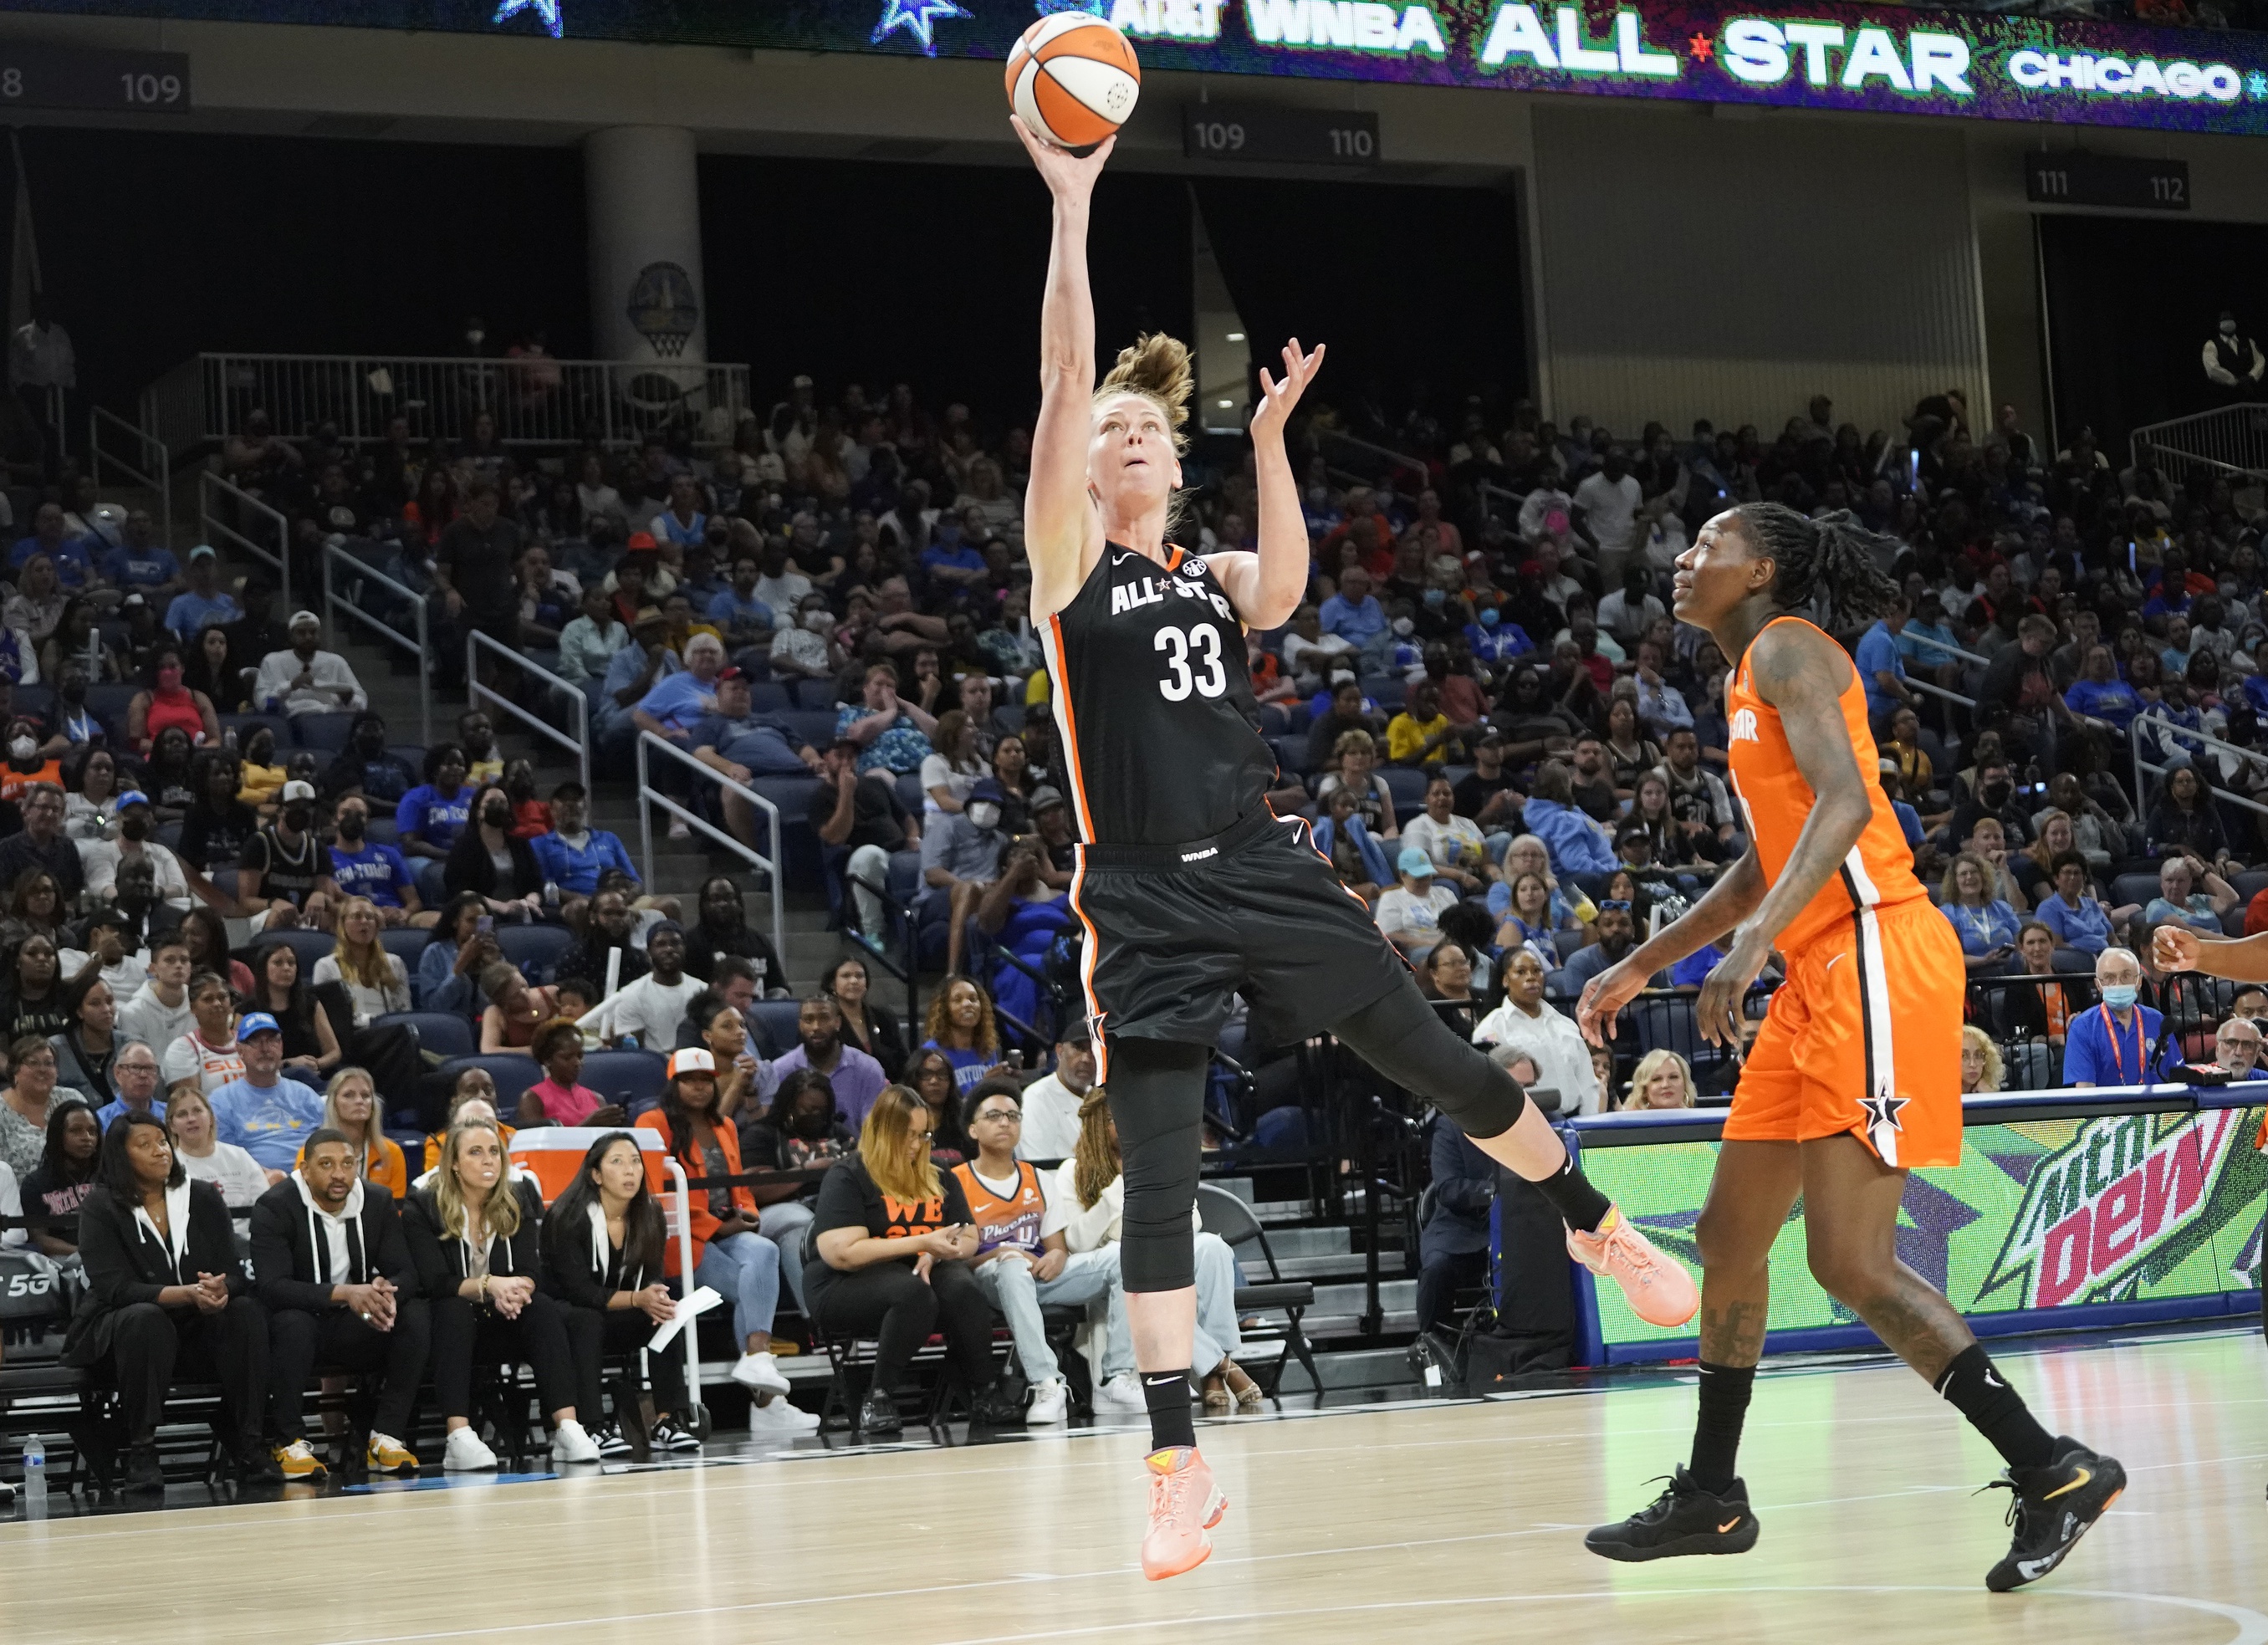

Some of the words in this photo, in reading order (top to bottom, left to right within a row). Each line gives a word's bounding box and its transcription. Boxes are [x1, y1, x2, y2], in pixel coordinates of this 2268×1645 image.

[1247, 0, 1445, 53] WNBA
[1481, 3, 1678, 76] ALL
[1724, 18, 1974, 94] STAR
[2008, 50, 2241, 101] CHICAGO
[121, 72, 181, 105] 109
[1194, 122, 1245, 151] 109
[1331, 129, 1372, 157] 110
[2038, 171, 2068, 197] 111
[2151, 176, 2184, 202] 112
[1111, 576, 1164, 616] ALL
[1172, 575, 1236, 622] STR
[1153, 622, 1227, 702] 33
[1181, 846, 1218, 863] WNBA
[881, 1195, 944, 1223] WE
[8, 1273, 50, 1297] 5G
